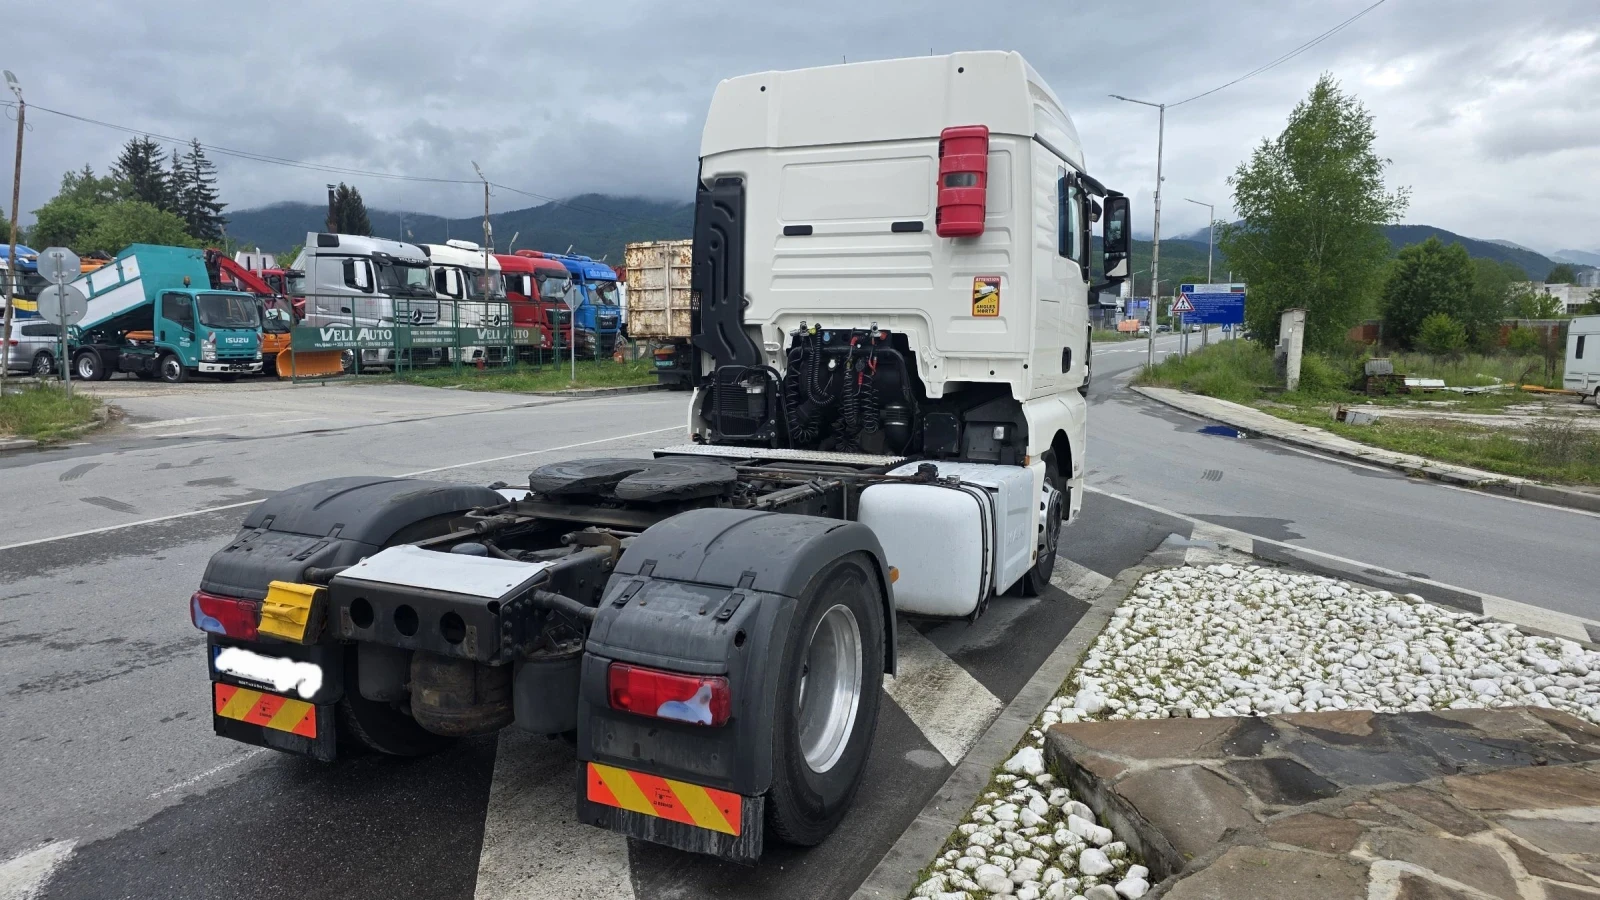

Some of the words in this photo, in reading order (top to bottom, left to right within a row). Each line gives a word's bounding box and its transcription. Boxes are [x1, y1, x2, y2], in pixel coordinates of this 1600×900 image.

[319, 328, 353, 342] VELI
[356, 328, 392, 341] AUTO
[477, 328, 500, 340] VELI
